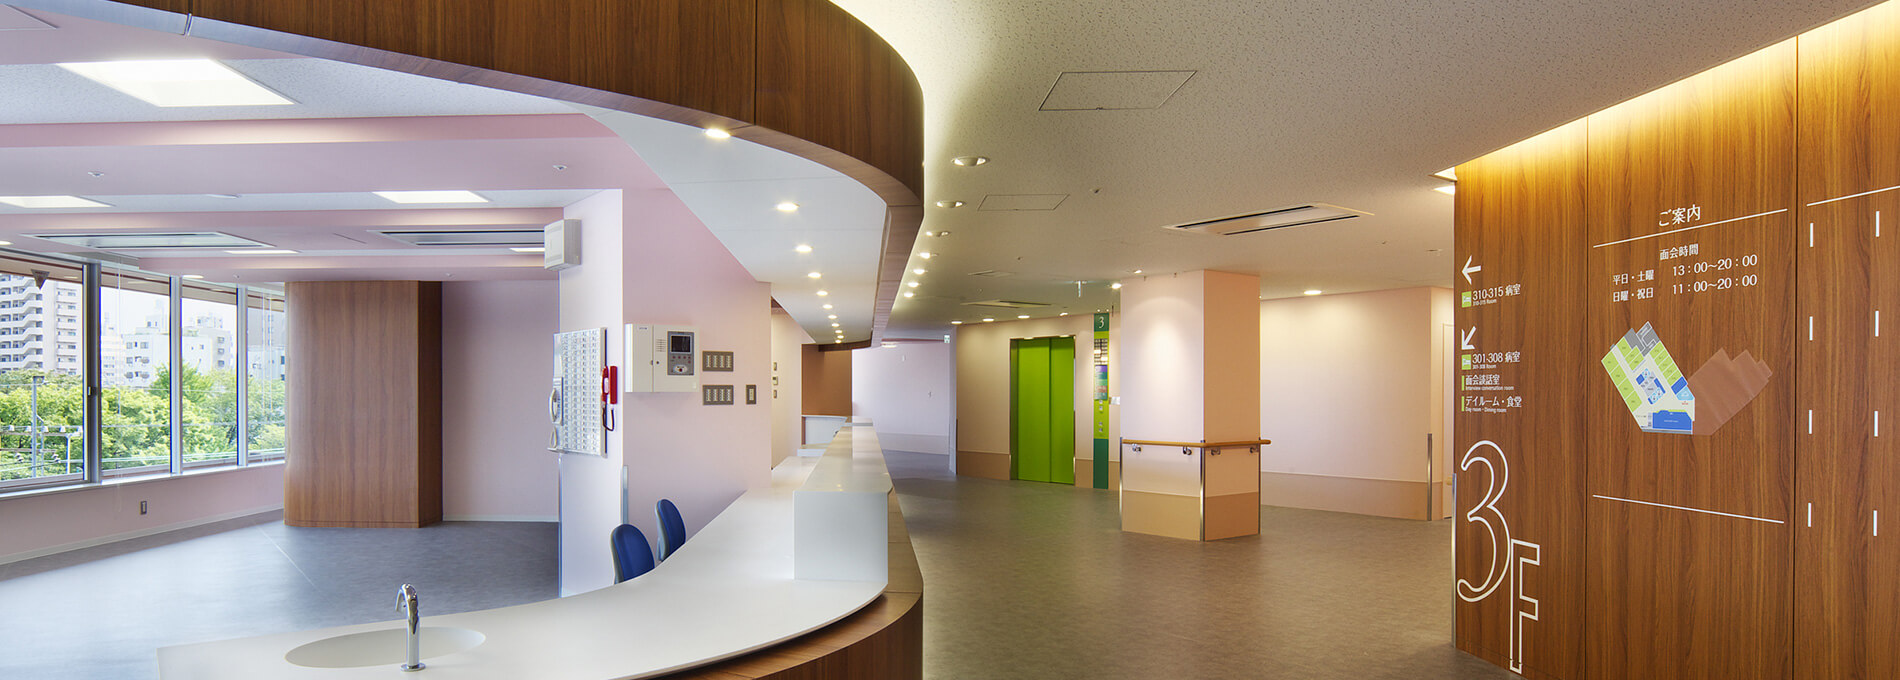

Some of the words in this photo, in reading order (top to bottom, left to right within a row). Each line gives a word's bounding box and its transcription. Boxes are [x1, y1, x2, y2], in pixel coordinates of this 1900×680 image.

[1658, 204, 1701, 227] ご案内
[1659, 244, 1699, 261] 面会時間
[1612, 269, 1655, 286] 平日・土曜
[1472, 286, 1504, 301] 310-315
[1505, 283, 1521, 297] 病室
[1612, 287, 1654, 302] 日曜・祝日
[1098, 316, 1105, 329] 3
[1472, 352, 1504, 364] 301-308
[1505, 351, 1521, 363] 病室
[1465, 396, 1522, 408] デイルーム・食堂
